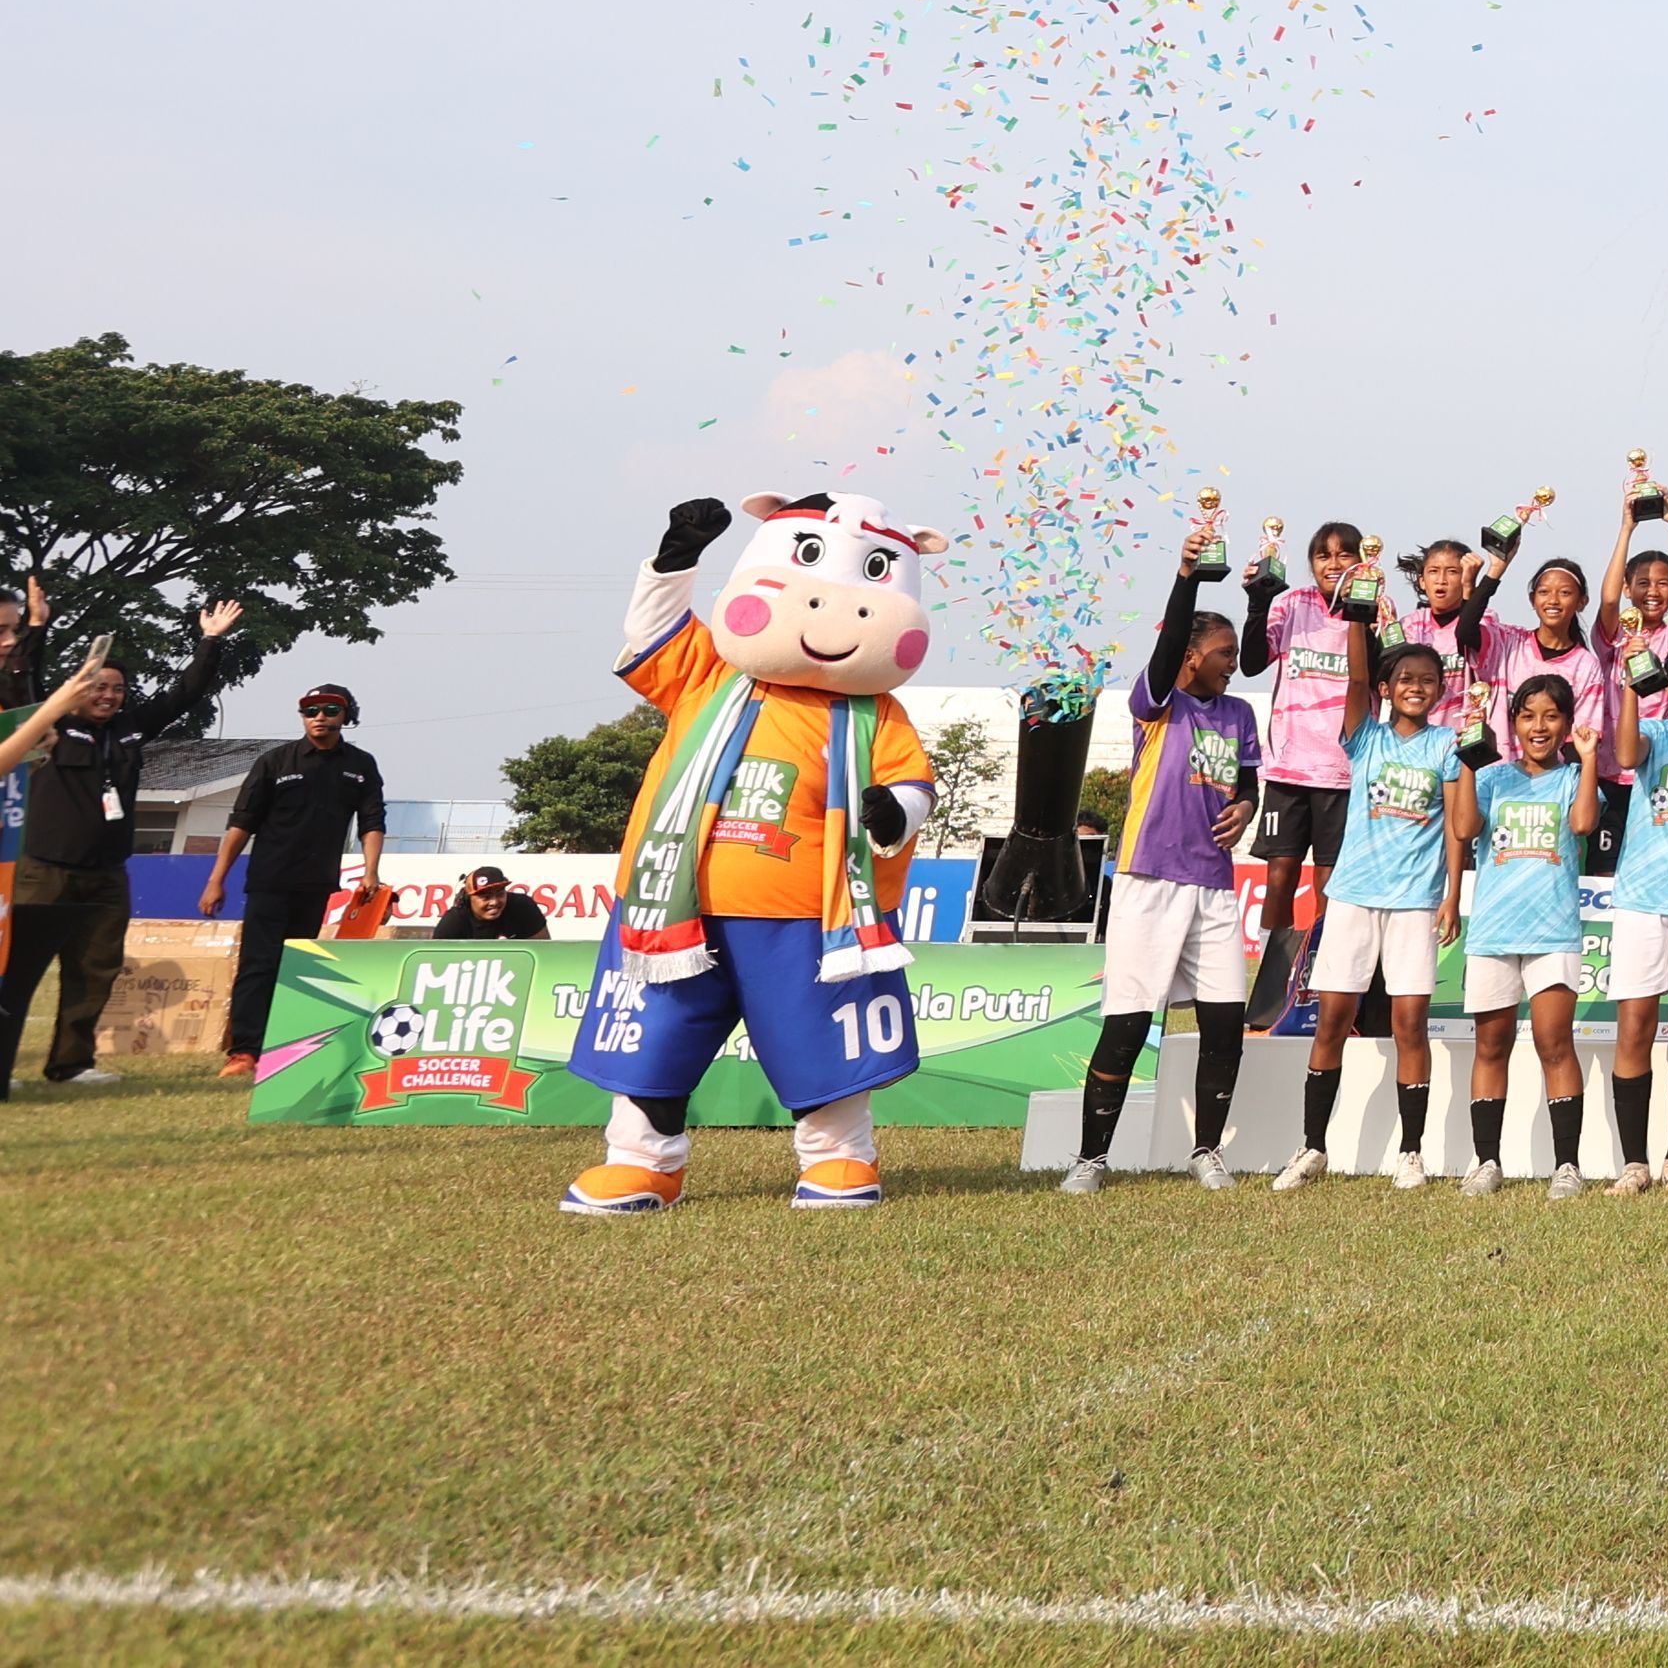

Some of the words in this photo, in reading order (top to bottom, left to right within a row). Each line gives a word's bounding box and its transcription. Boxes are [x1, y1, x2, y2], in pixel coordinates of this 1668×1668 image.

[1288, 649, 1349, 673] MilkLif
[1385, 767, 1432, 793] Milk
[1389, 788, 1429, 812] Life
[716, 820, 759, 832] SOCCER
[1264, 811, 1279, 836] 11
[1505, 803, 1555, 828] Milk
[711, 829, 767, 842] HALLENGE
[1512, 826, 1556, 849] Life
[412, 959, 517, 1007] Milk
[960, 986, 1053, 1023] Putri
[421, 1005, 515, 1053] Life
[593, 1010, 645, 1054] Life
[831, 994, 904, 1061] 10
[418, 1058, 481, 1072] SOCCER
[402, 1074, 492, 1088] CHALLENGE
